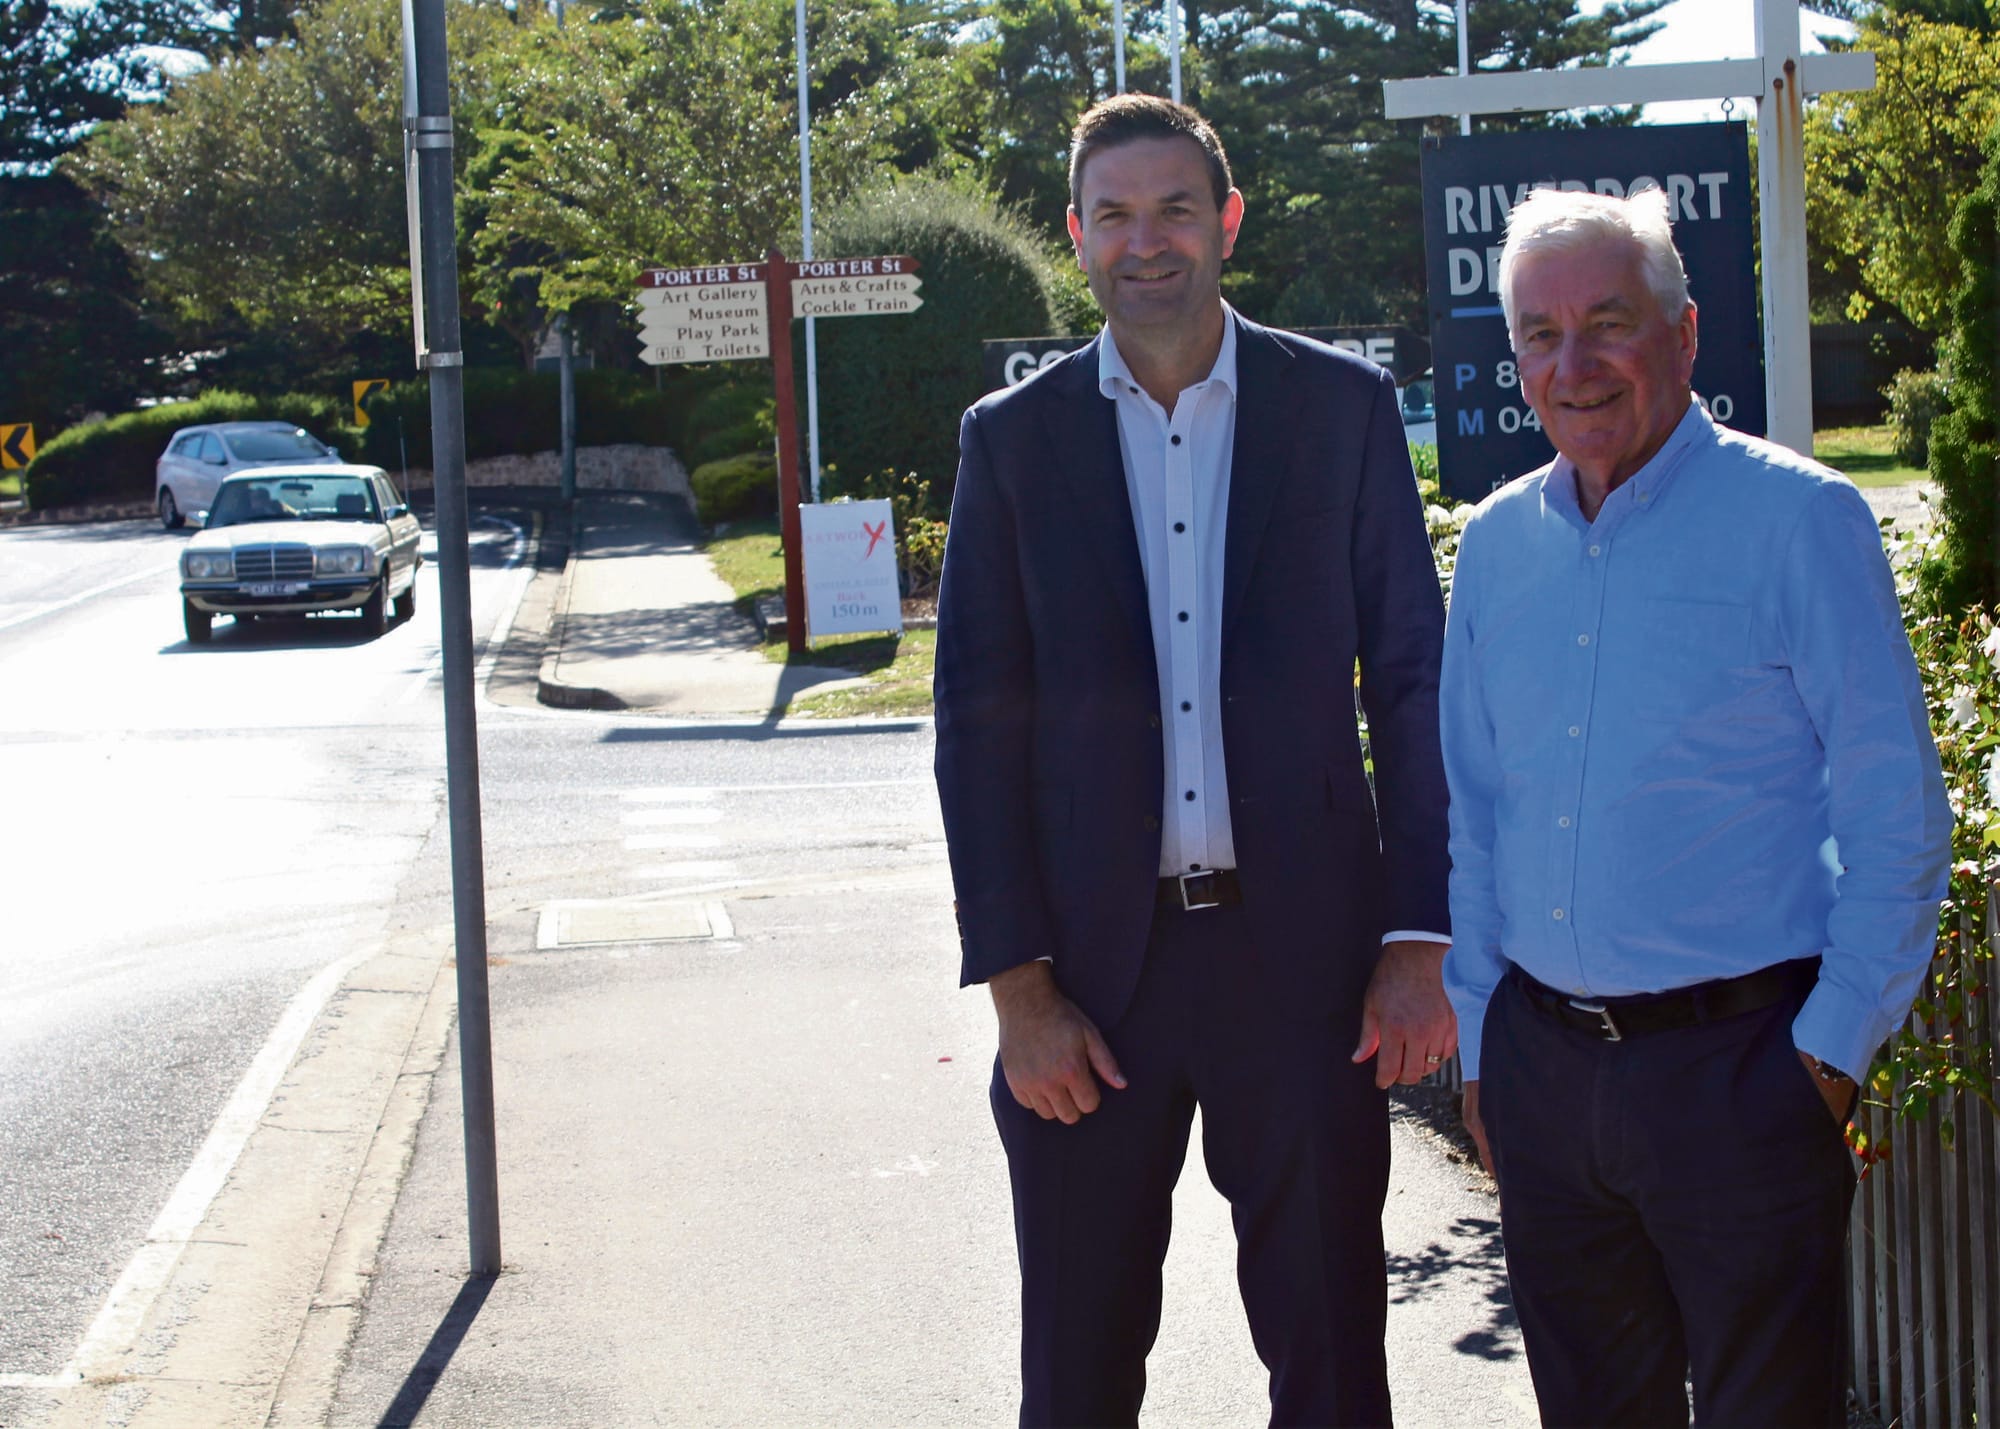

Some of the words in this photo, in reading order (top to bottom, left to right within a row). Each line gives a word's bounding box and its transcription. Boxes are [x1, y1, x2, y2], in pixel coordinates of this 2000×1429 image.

[654, 267, 730, 286] PORTER
[738, 266, 757, 280] St
[799, 260, 874, 277] PORTER
[882, 259, 901, 273] St
[662, 290, 690, 304] Art
[698, 287, 757, 302] Gallery
[801, 283, 836, 296] Arts
[839, 280, 852, 293] &
[856, 278, 908, 292] Crafts
[689, 308, 759, 321] Museum
[801, 299, 857, 314] Cockle
[864, 298, 908, 311] Train
[677, 327, 713, 341] Play
[721, 323, 760, 337] Park
[703, 343, 761, 358] Toilets
[1455, 364, 1477, 391] P
[1457, 408, 1484, 436] M
